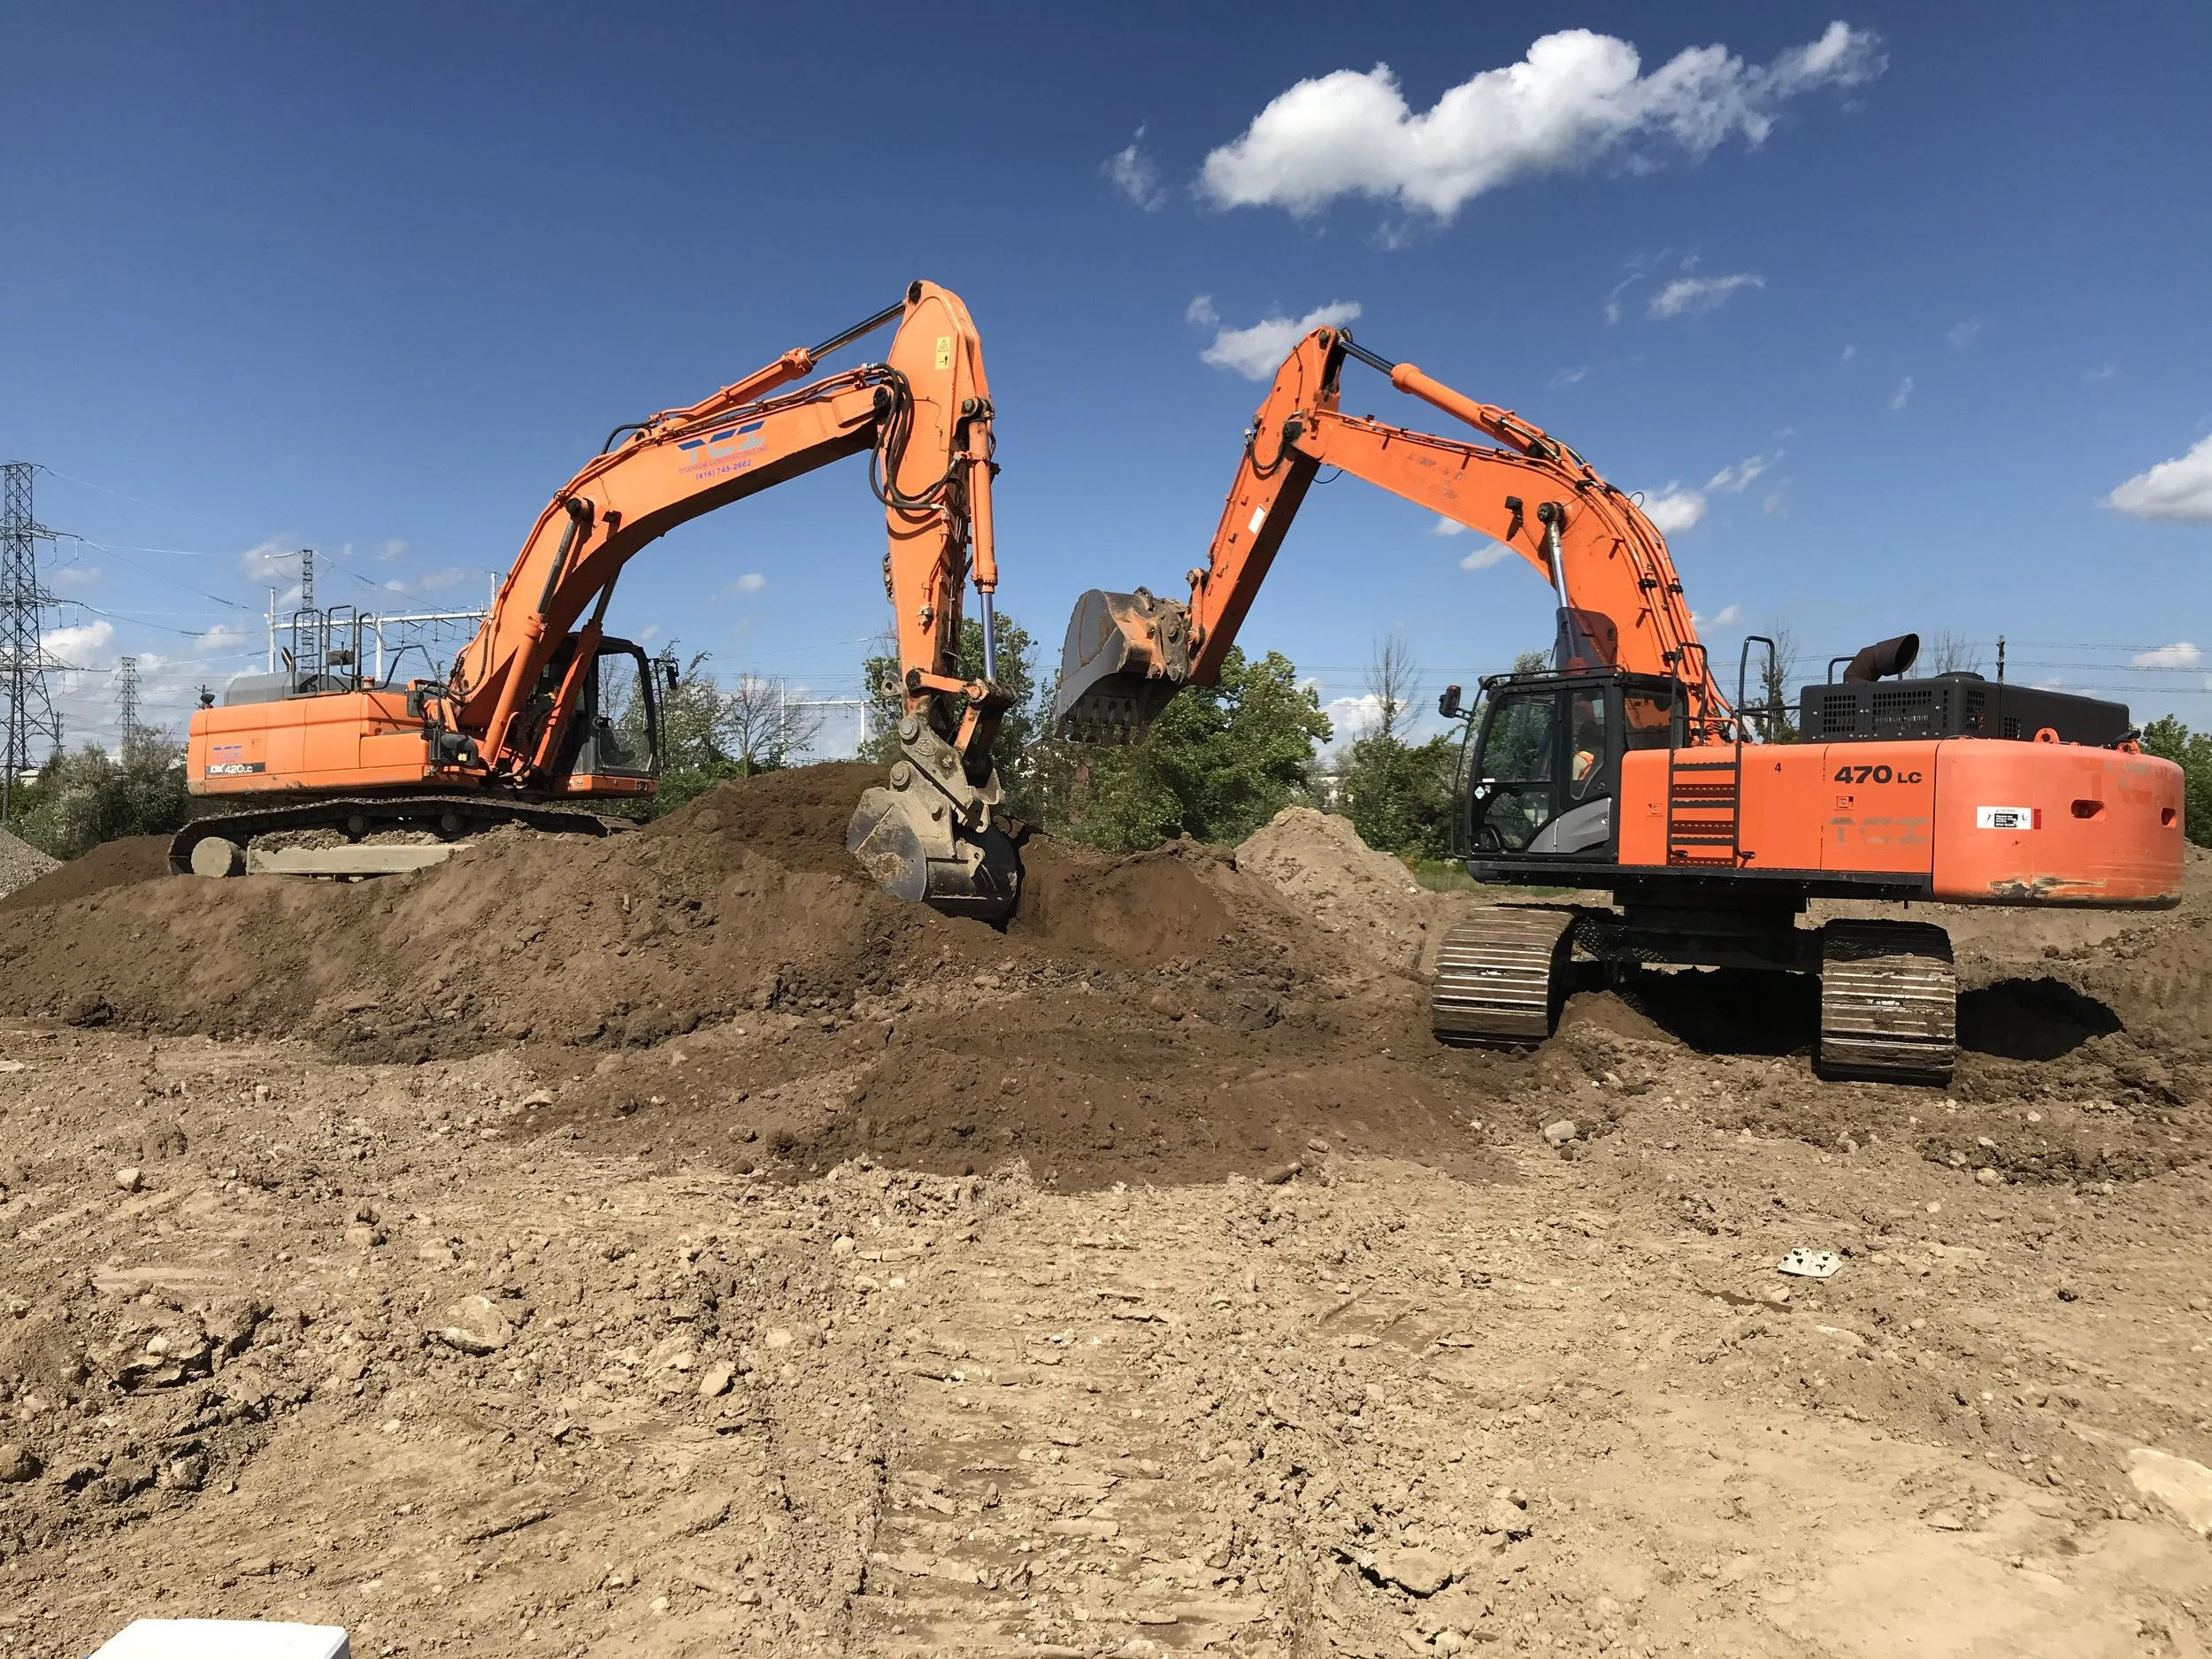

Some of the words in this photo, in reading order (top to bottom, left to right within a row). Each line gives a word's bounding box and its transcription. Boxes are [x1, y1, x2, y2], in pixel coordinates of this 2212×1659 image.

[696, 469, 715, 480] (416)
[1774, 763, 1782, 773] 4
[1834, 765, 1892, 784] 470
[1898, 772, 1922, 784] LC
